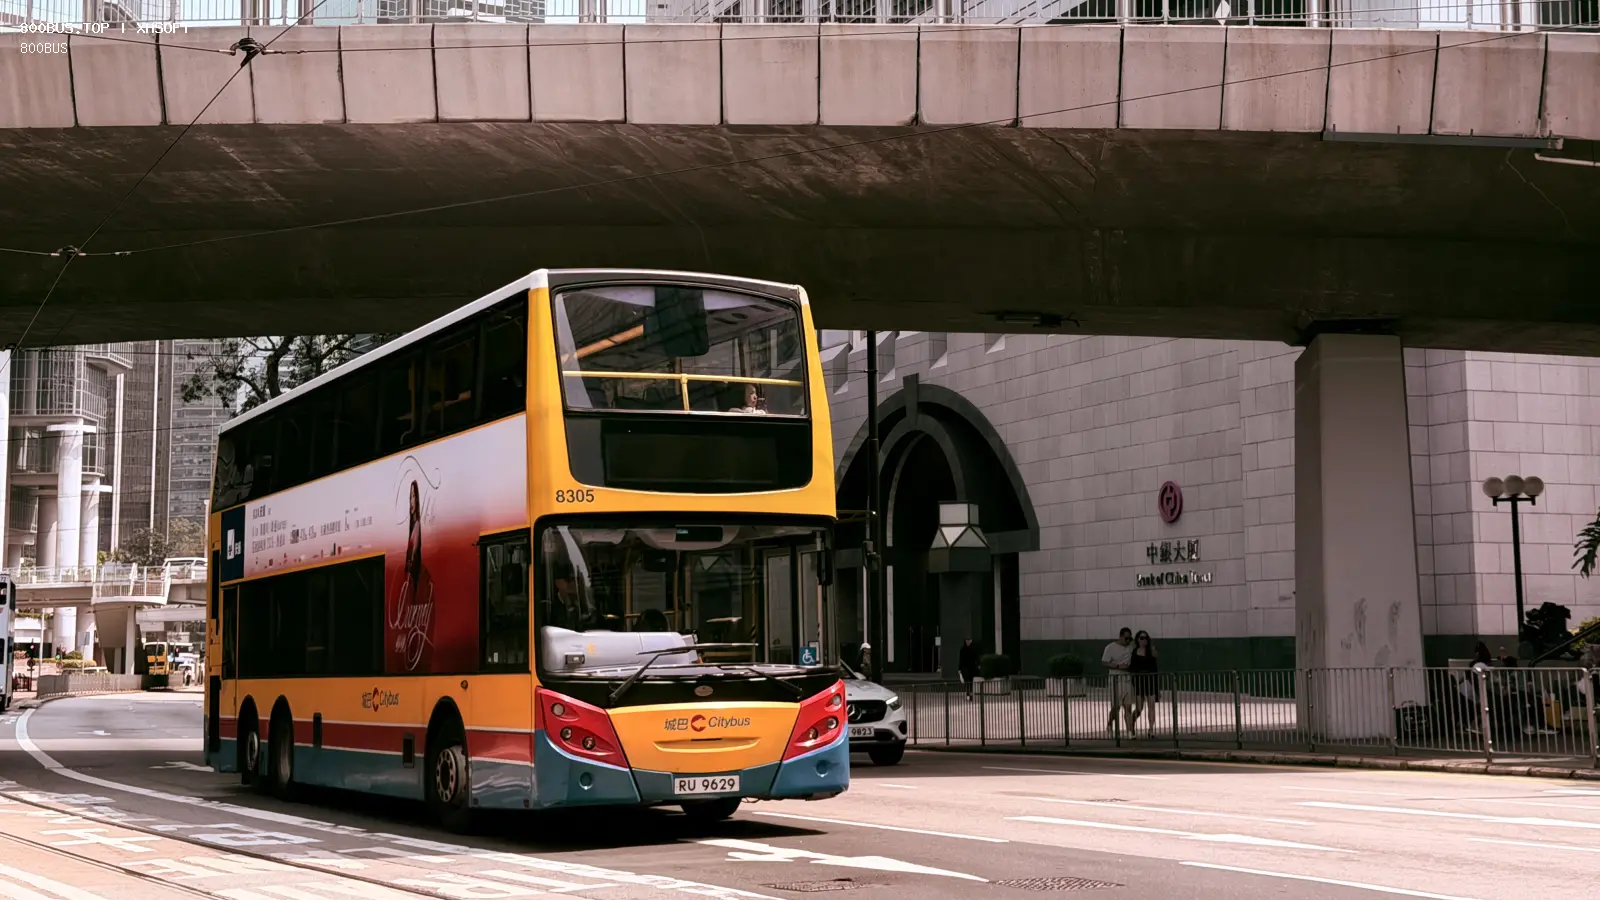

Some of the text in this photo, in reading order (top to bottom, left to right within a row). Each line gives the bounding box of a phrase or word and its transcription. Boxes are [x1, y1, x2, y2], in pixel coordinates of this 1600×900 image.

[555, 489, 595, 503] 8305
[664, 718, 689, 731] 城巴
[708, 716, 751, 729] Citybus
[678, 778, 735, 792] RU 9629
